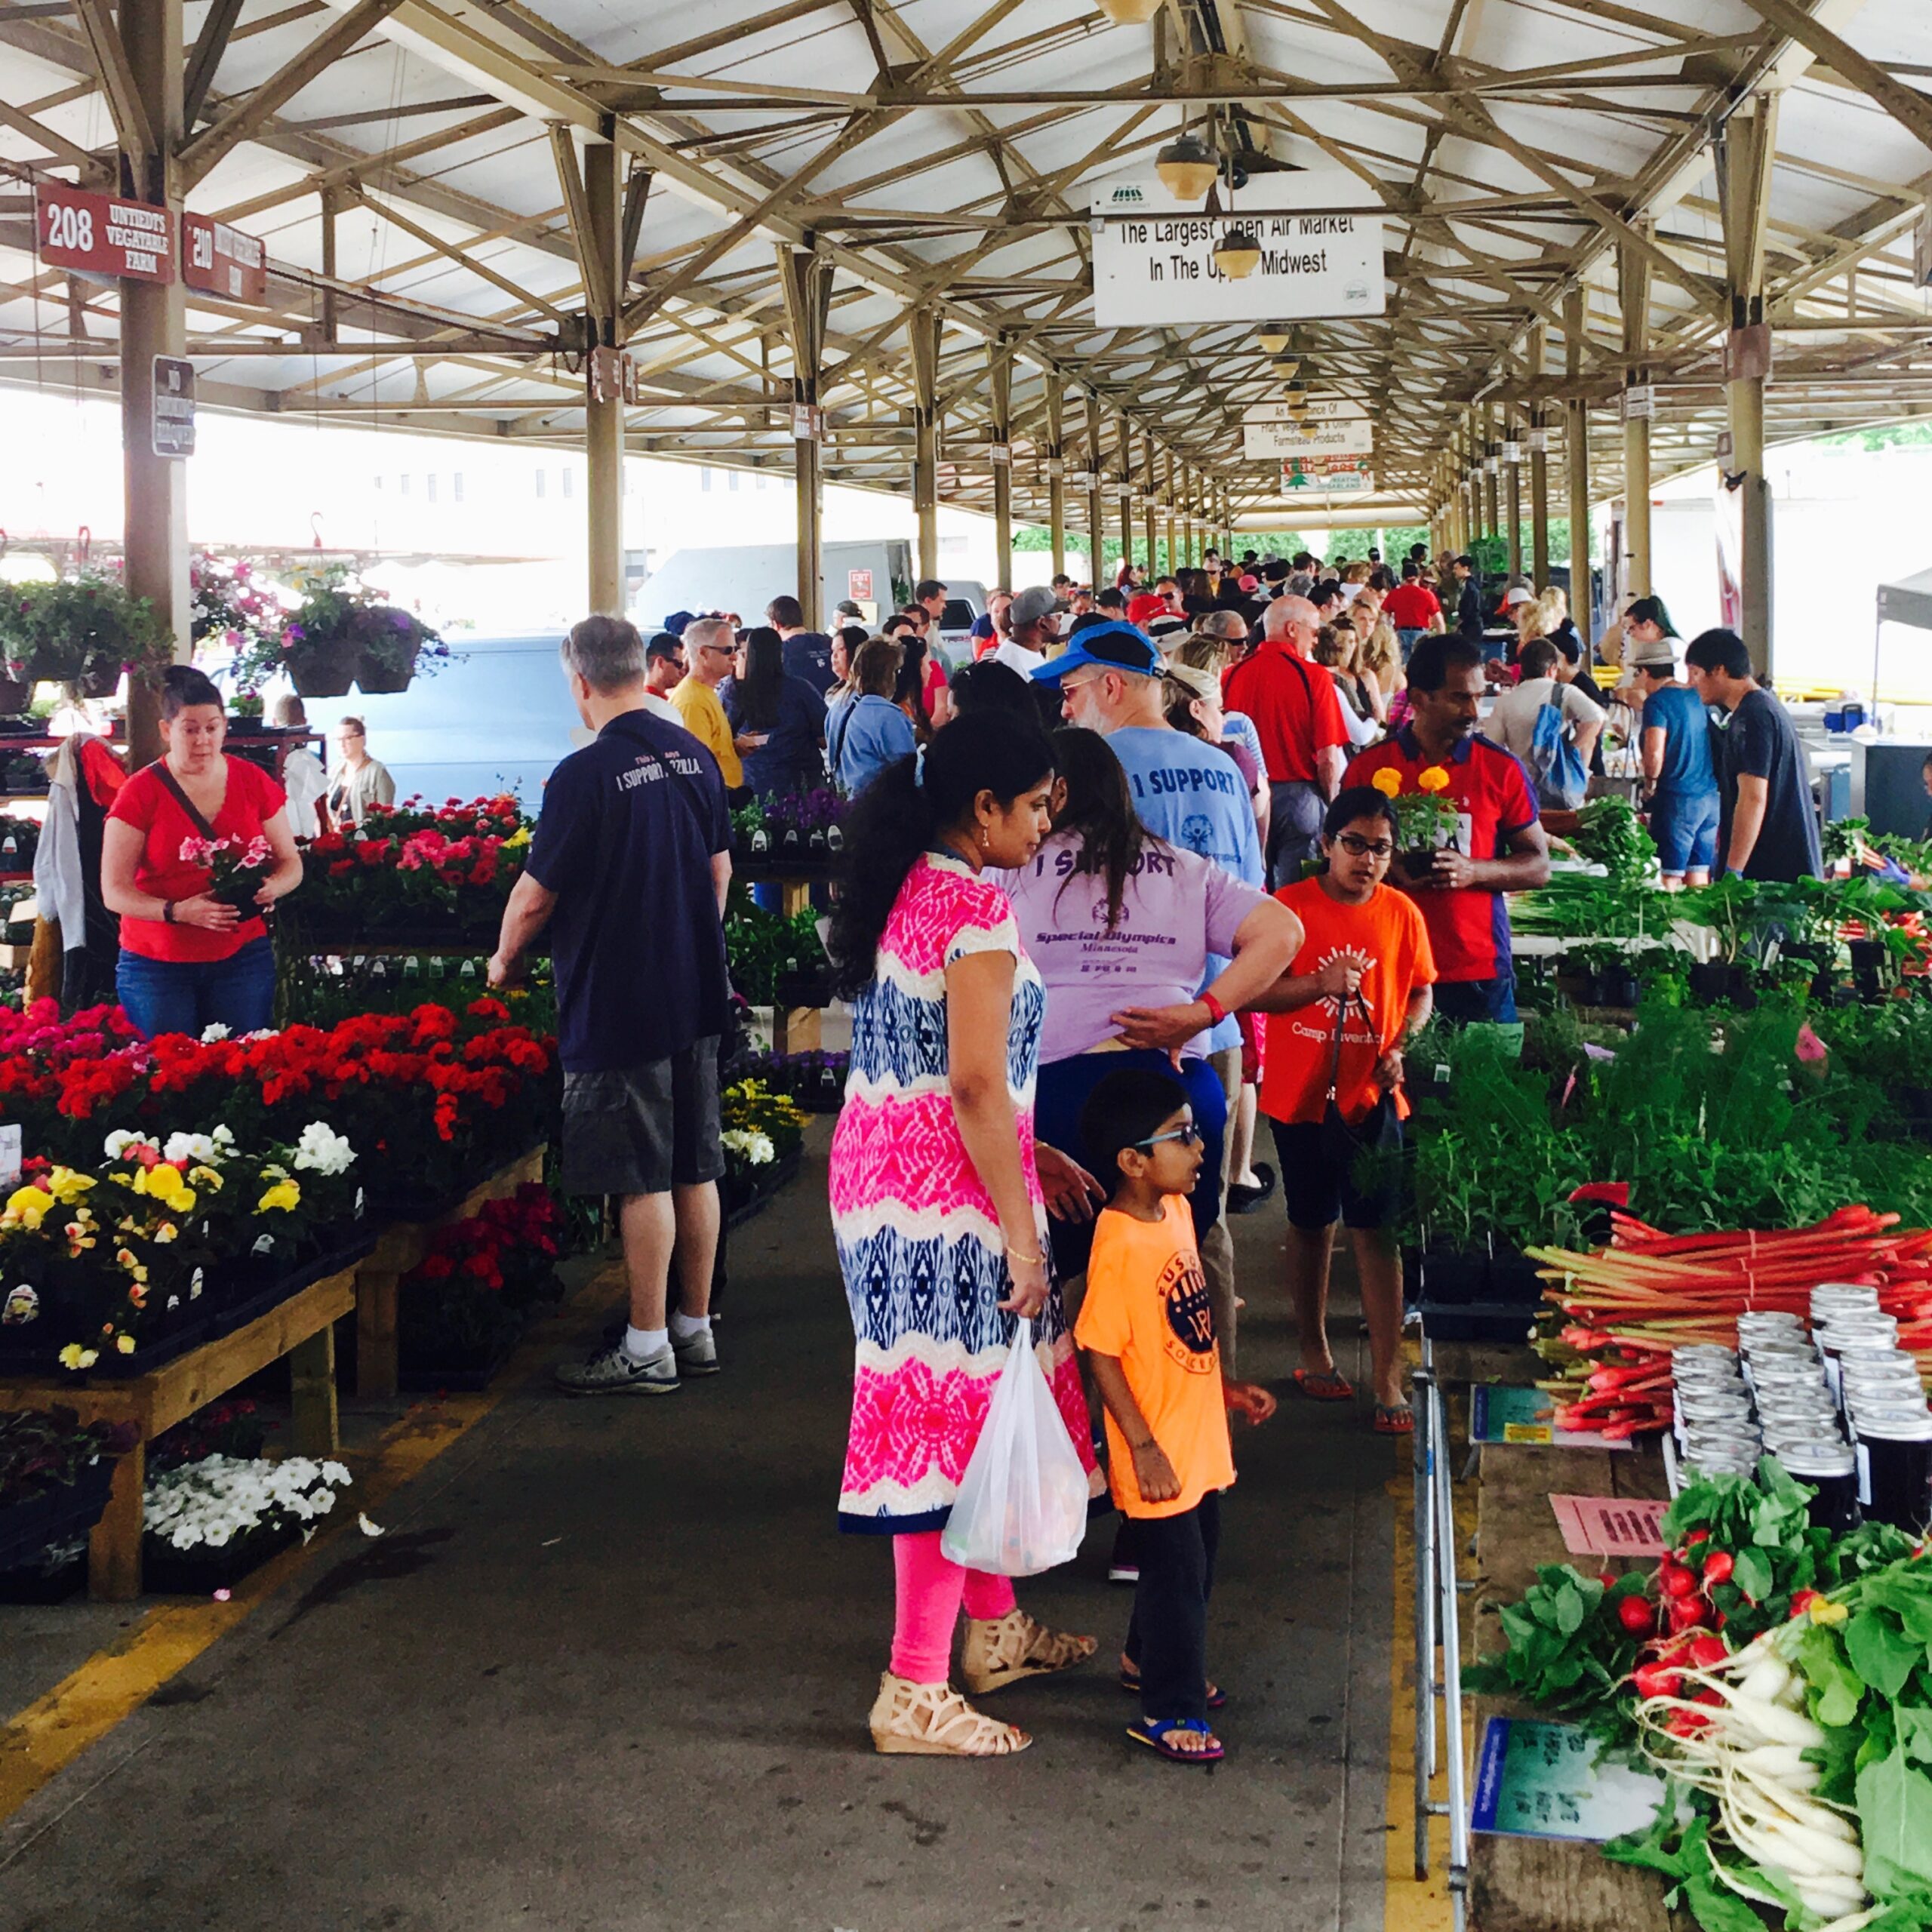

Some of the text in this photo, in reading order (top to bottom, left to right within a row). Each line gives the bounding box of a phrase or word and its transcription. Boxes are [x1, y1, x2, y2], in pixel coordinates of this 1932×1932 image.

[48, 203, 94, 252] 208
[1121, 223, 1147, 244] The
[1155, 220, 1215, 247] Largest
[1271, 218, 1291, 237] Air
[1299, 217, 1354, 235] Market
[125, 250, 158, 274] FARM
[1149, 257, 1163, 281] In
[1170, 254, 1199, 279] The
[1262, 248, 1327, 275] Midwest
[616, 775, 623, 792] I
[623, 761, 664, 789] SUPPORT
[1133, 768, 1235, 798] I SUPPORT
[1035, 848, 1176, 878] I SORT
[1035, 931, 1177, 945] Special Olympics
[1079, 943, 1138, 954] Minnesota
[1291, 1021, 1327, 1044] Camp
